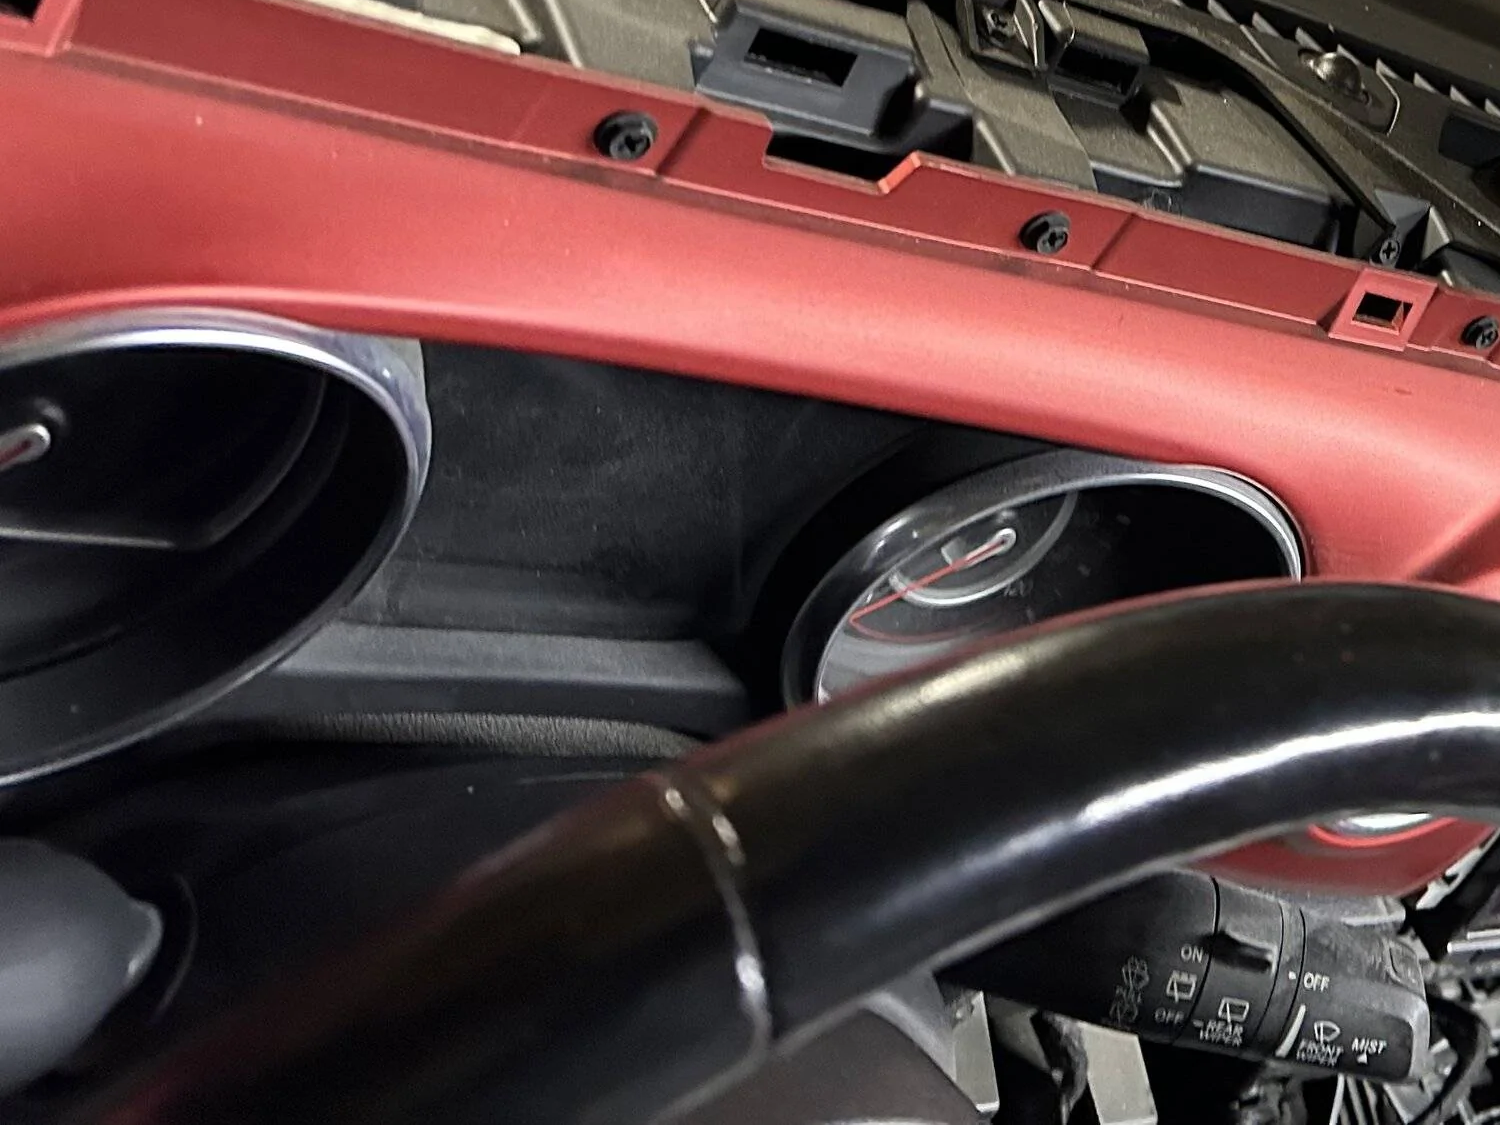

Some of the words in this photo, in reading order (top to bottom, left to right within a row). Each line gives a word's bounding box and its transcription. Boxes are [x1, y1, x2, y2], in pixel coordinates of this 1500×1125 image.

[1180, 943, 1205, 963] ON
[1303, 971, 1330, 992] OFF
[1153, 1007, 1185, 1025] OFF
[1207, 1019, 1244, 1037] REAR
[1298, 1038, 1344, 1059] FRONT
[1351, 1036, 1388, 1055] MIST
